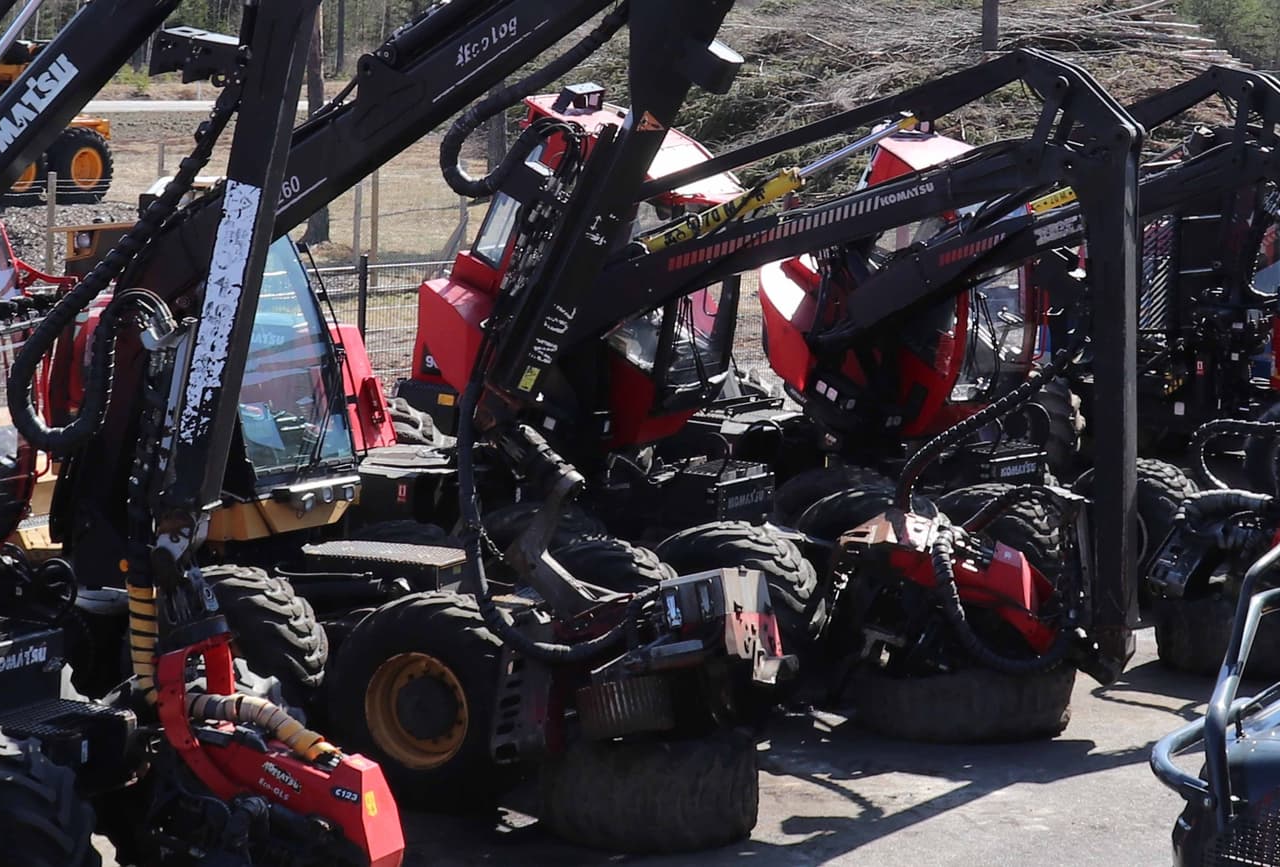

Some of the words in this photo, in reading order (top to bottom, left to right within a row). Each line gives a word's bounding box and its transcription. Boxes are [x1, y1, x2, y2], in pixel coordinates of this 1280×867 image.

[277, 175, 301, 203] 60
[880, 182, 934, 207] KOMATSU
[335, 788, 359, 801] C123
